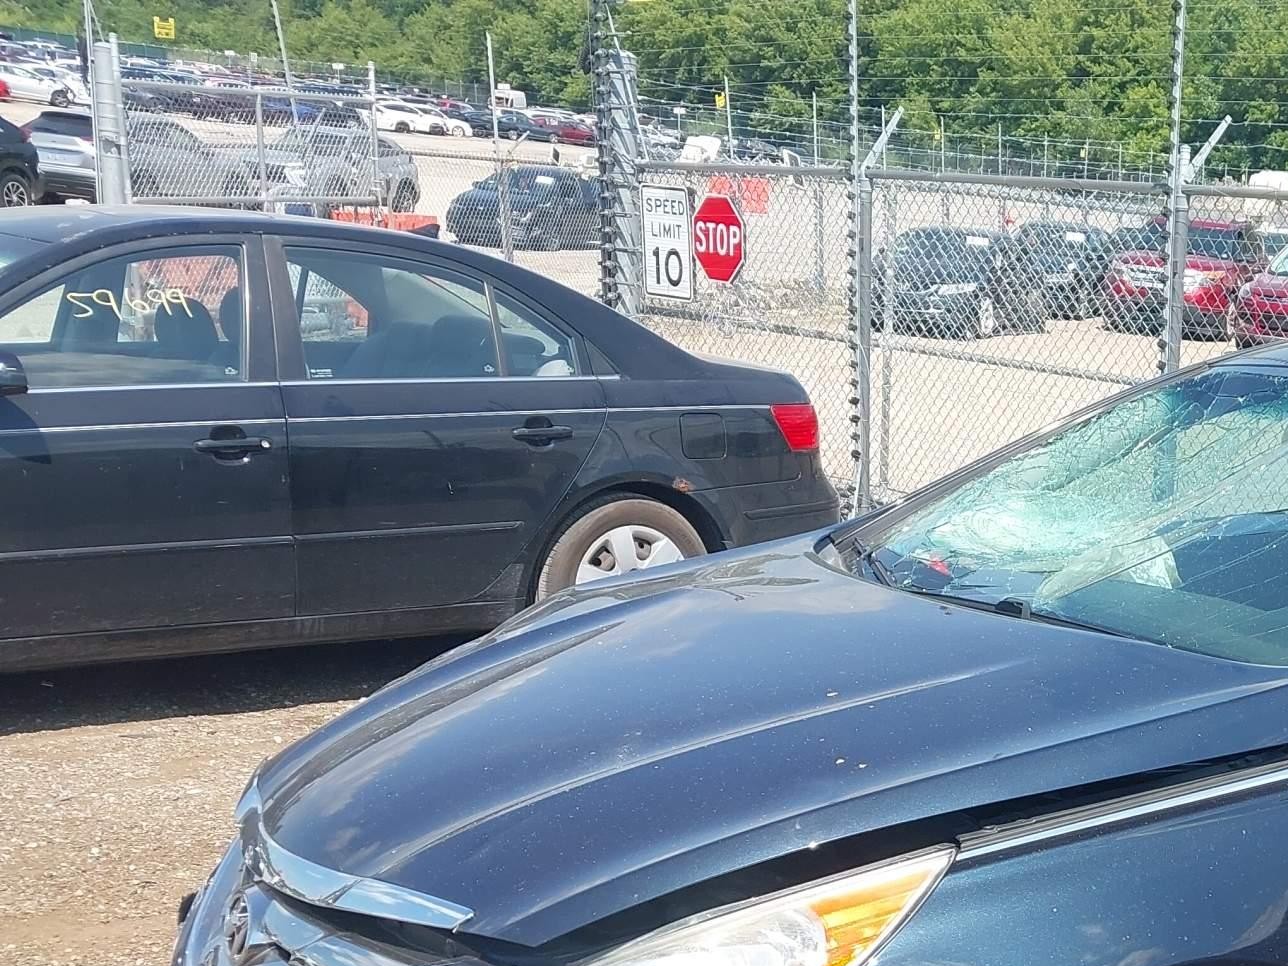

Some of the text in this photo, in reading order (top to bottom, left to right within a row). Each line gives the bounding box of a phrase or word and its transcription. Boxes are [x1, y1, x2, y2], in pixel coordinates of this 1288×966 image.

[645, 198, 685, 215] SPEED
[650, 221, 682, 240] LIMIT
[696, 221, 740, 256] STOP
[652, 246, 683, 287] 10
